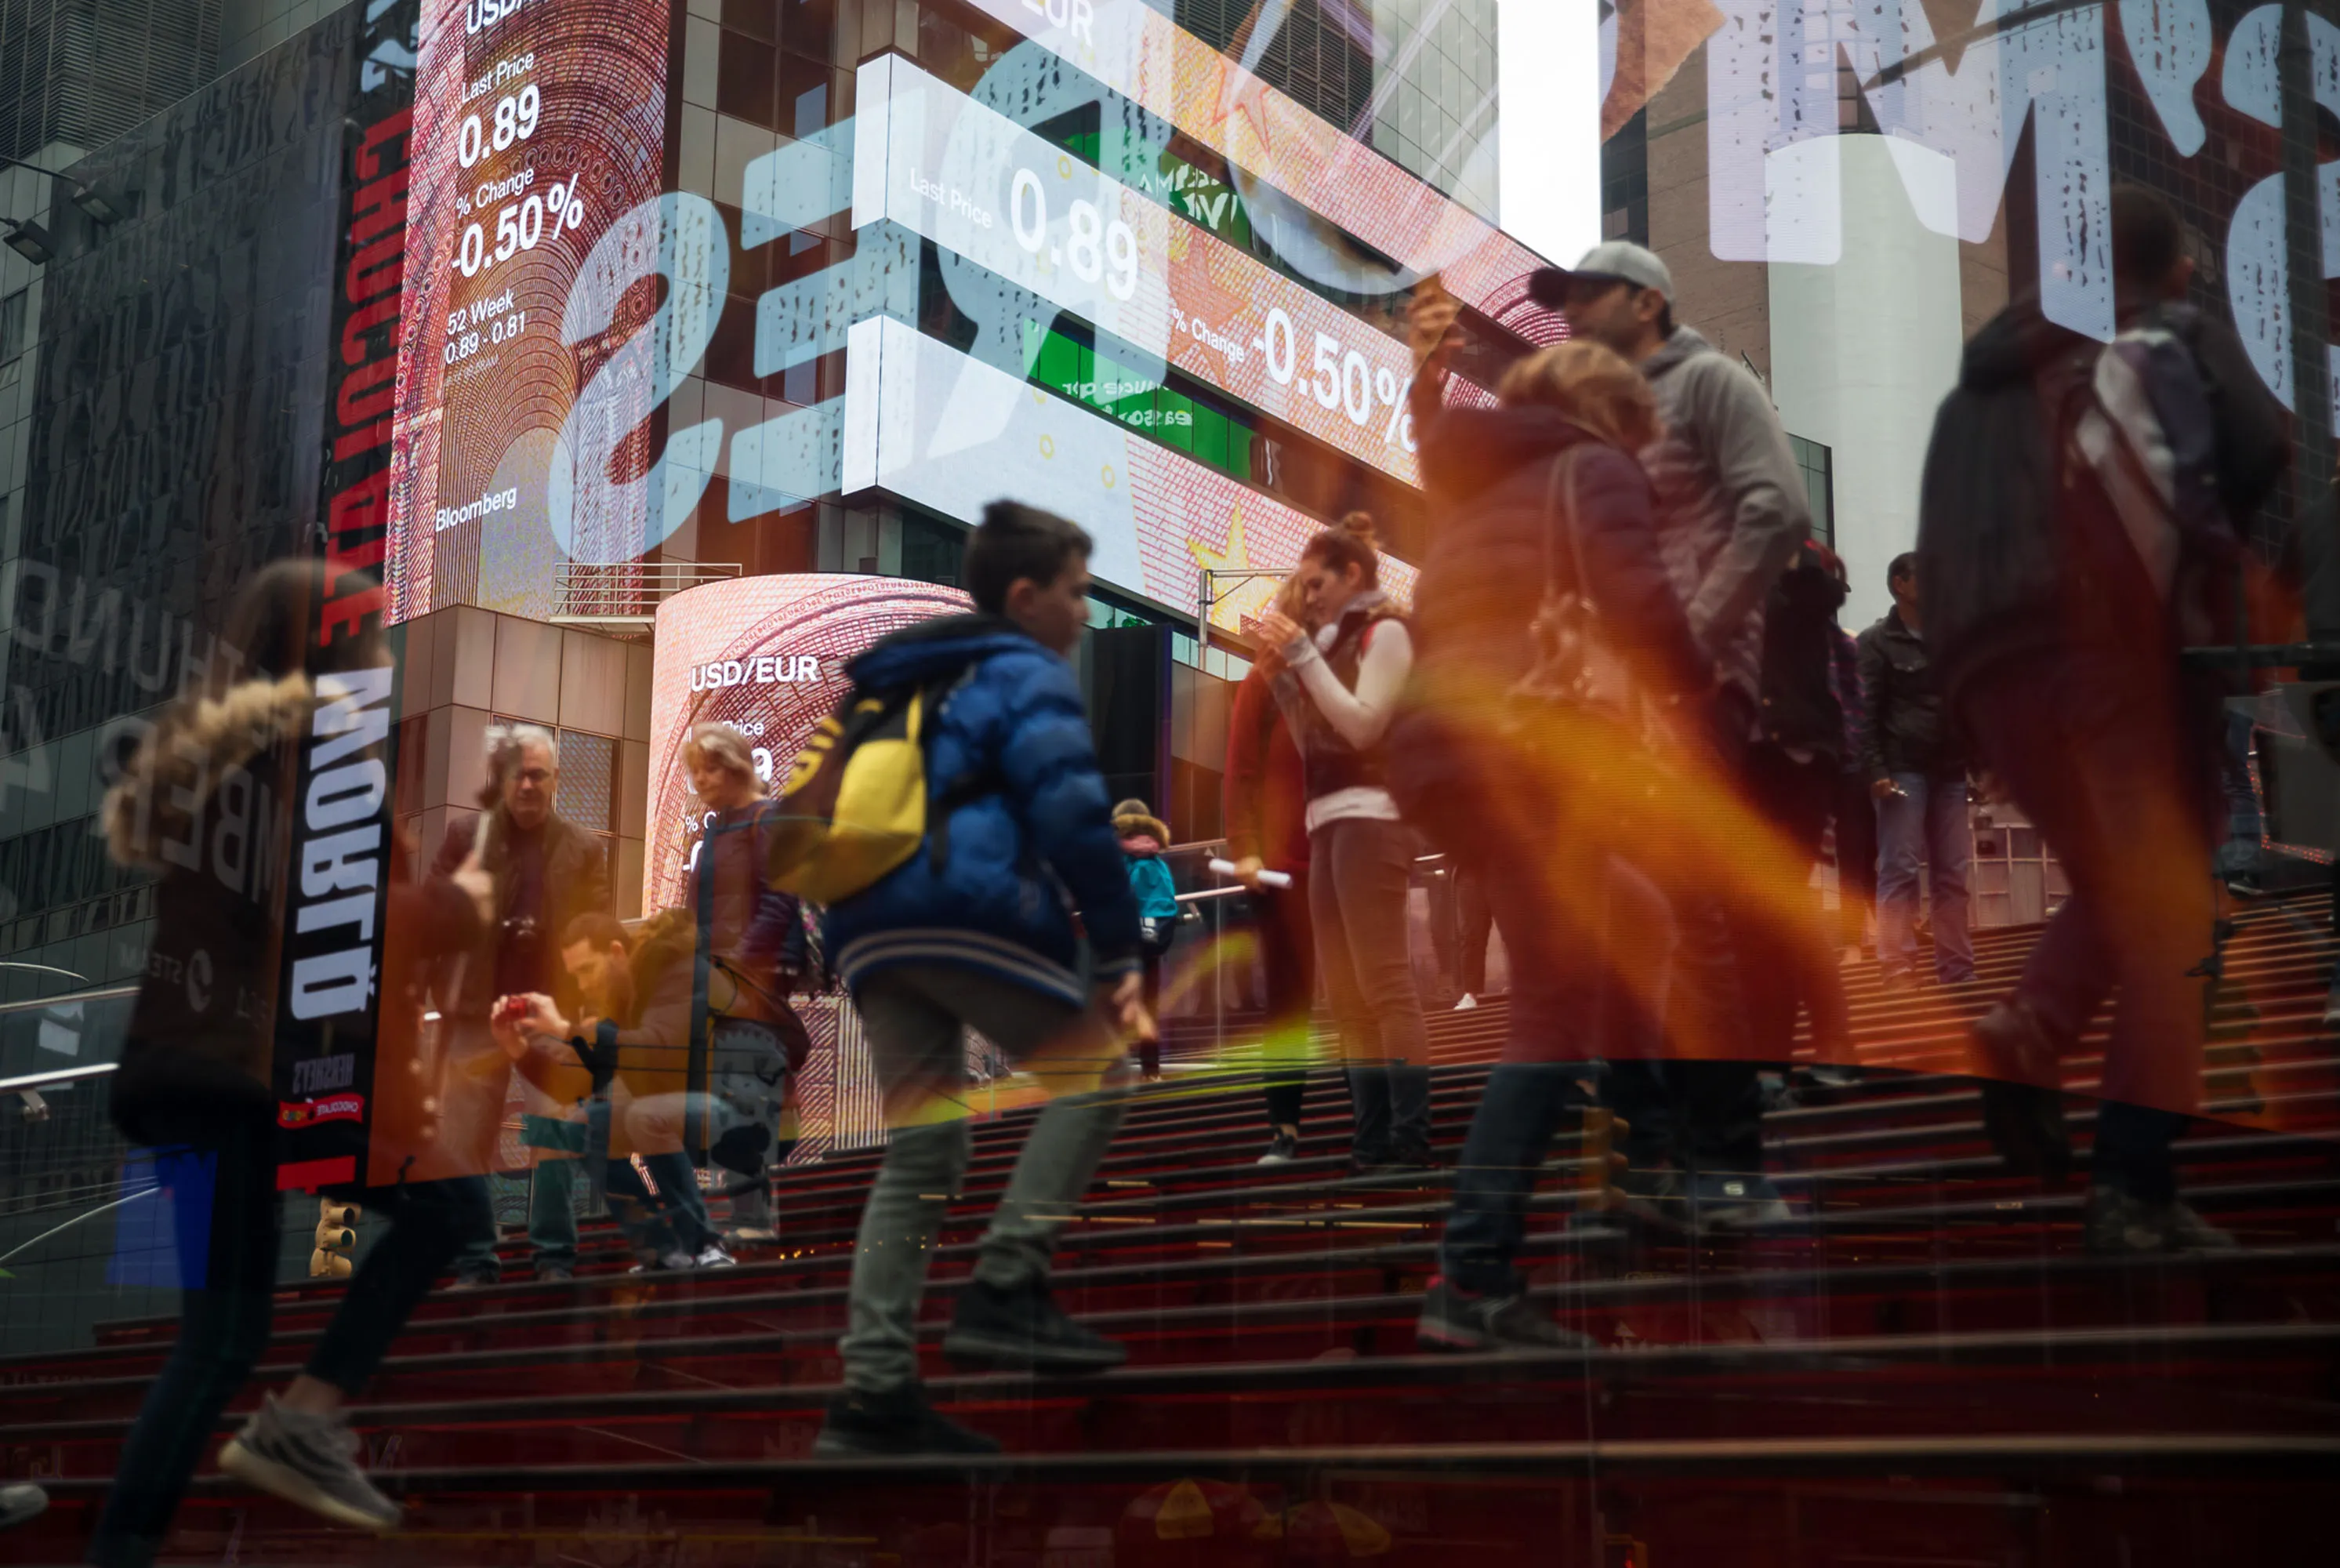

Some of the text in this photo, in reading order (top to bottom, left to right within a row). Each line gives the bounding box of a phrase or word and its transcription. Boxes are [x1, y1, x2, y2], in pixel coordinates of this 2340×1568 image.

[466, 0, 526, 34] USD
[1021, 0, 1093, 48] UR
[462, 52, 535, 103] Last Price
[459, 84, 539, 169] 0.89
[456, 168, 534, 219] % Change
[910, 167, 992, 229] Last Price
[1010, 168, 1137, 301] 0.89
[445, 332, 478, 365] 0.89
[493, 310, 526, 345] 0.81
[447, 289, 514, 336] 52 Week
[1173, 308, 1187, 333] %
[1192, 318, 1245, 363] Change
[435, 487, 517, 532] Bloomberg
[691, 655, 818, 692] USD/EUR
